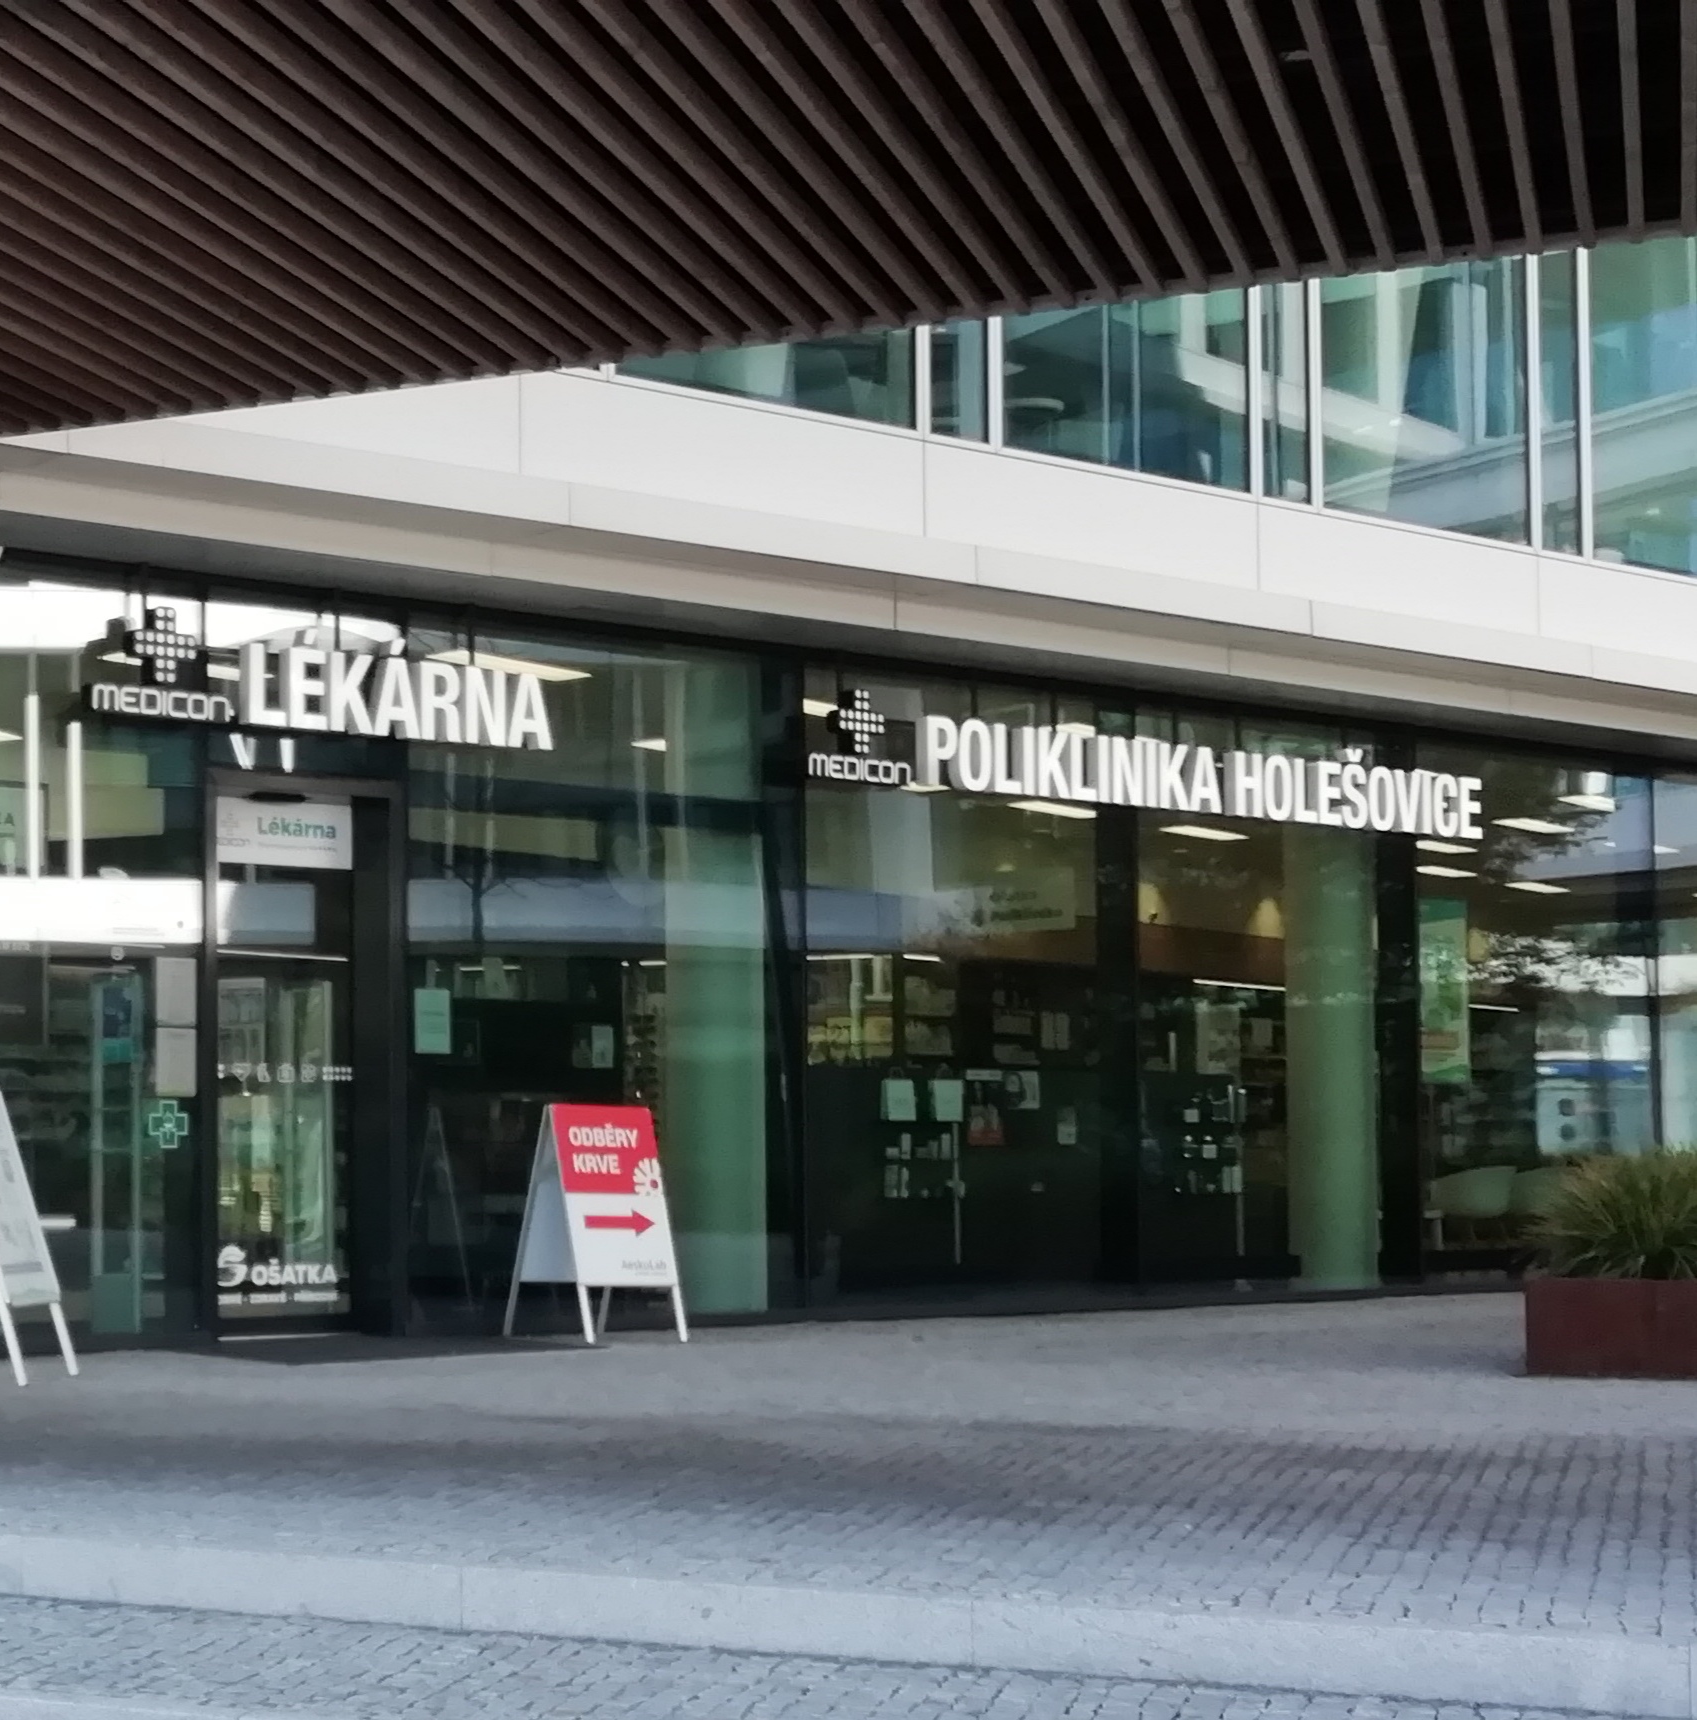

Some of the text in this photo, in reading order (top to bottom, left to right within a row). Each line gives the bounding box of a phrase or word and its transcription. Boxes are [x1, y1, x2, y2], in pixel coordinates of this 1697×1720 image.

[90, 682, 231, 722] MEDICON
[242, 628, 553, 751] LÉKÁRNA
[808, 753, 911, 786] MEDICON
[918, 715, 1484, 840] POLIKLINIKA HOLEŠOVICE
[257, 816, 337, 840] Lékárna
[568, 1123, 639, 1150] ODBĚRY
[572, 1153, 622, 1176] KRVE
[250, 1257, 339, 1287] OŠATKA
